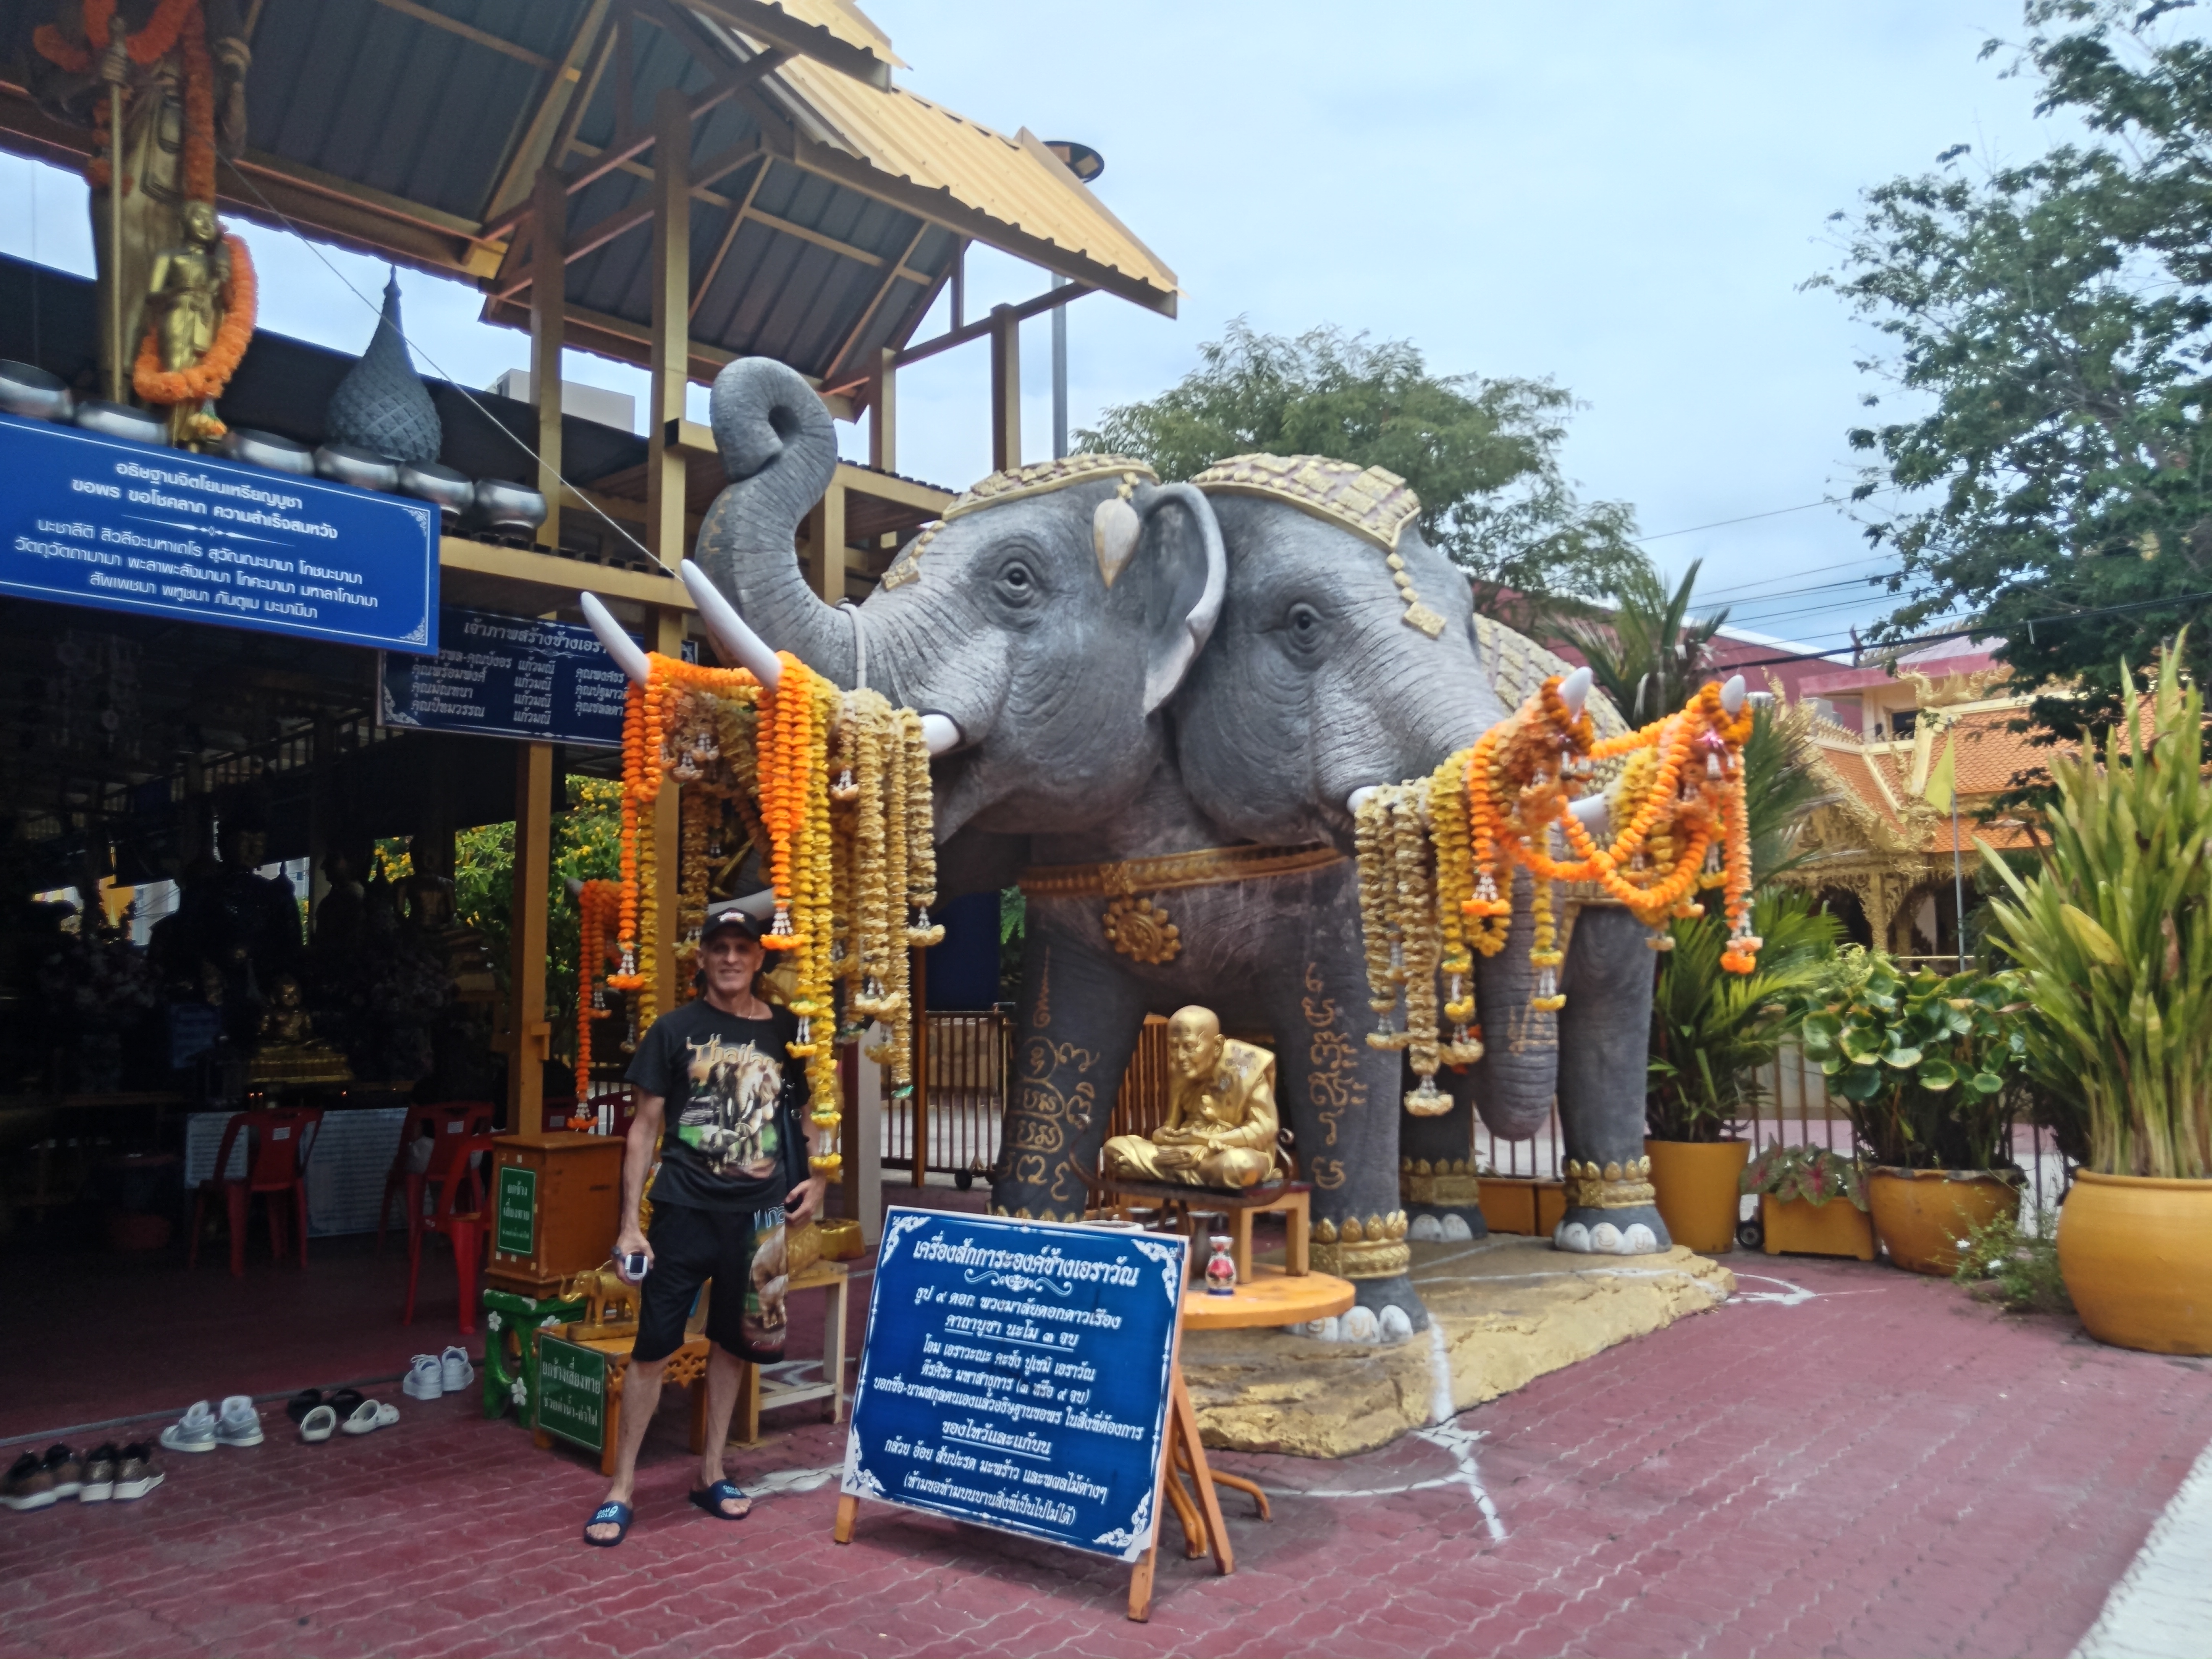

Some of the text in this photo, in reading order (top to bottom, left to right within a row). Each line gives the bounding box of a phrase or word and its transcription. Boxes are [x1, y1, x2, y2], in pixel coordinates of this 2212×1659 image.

[116, 462, 302, 509] อธิษฐานจิตโยนเหรียญบูชา
[71, 479, 338, 539] ขอพร ขอโชคลาภ ความสำเร็จสมหวัง
[913, 1230, 1140, 1287] เครื่องสักการะองค์ช้างเอราวัณ
[914, 1285, 1123, 1330] ธูป ๙ ดอก พวงมาลัยดอกดาวเรือง
[944, 1314, 1003, 1338] คาถาบูชา
[1006, 1319, 1040, 1341] นะโม
[1059, 1332, 1080, 1347] จบ
[923, 1333, 942, 1355] โอม
[1054, 1361, 1096, 1382] เอราวัณ
[1032, 1379, 1055, 1399] หรือ
[1069, 1388, 1091, 1405] จบ)
[942, 1418, 1052, 1455] ของไหว้และแก้บน
[1064, 1405, 1145, 1441] ในสิ่งที่ต้องการ
[884, 1435, 911, 1456] กล้วย
[912, 1439, 934, 1462] อ้อย
[935, 1445, 977, 1470] สับปะรด
[979, 1458, 1020, 1481] มะพร้าว
